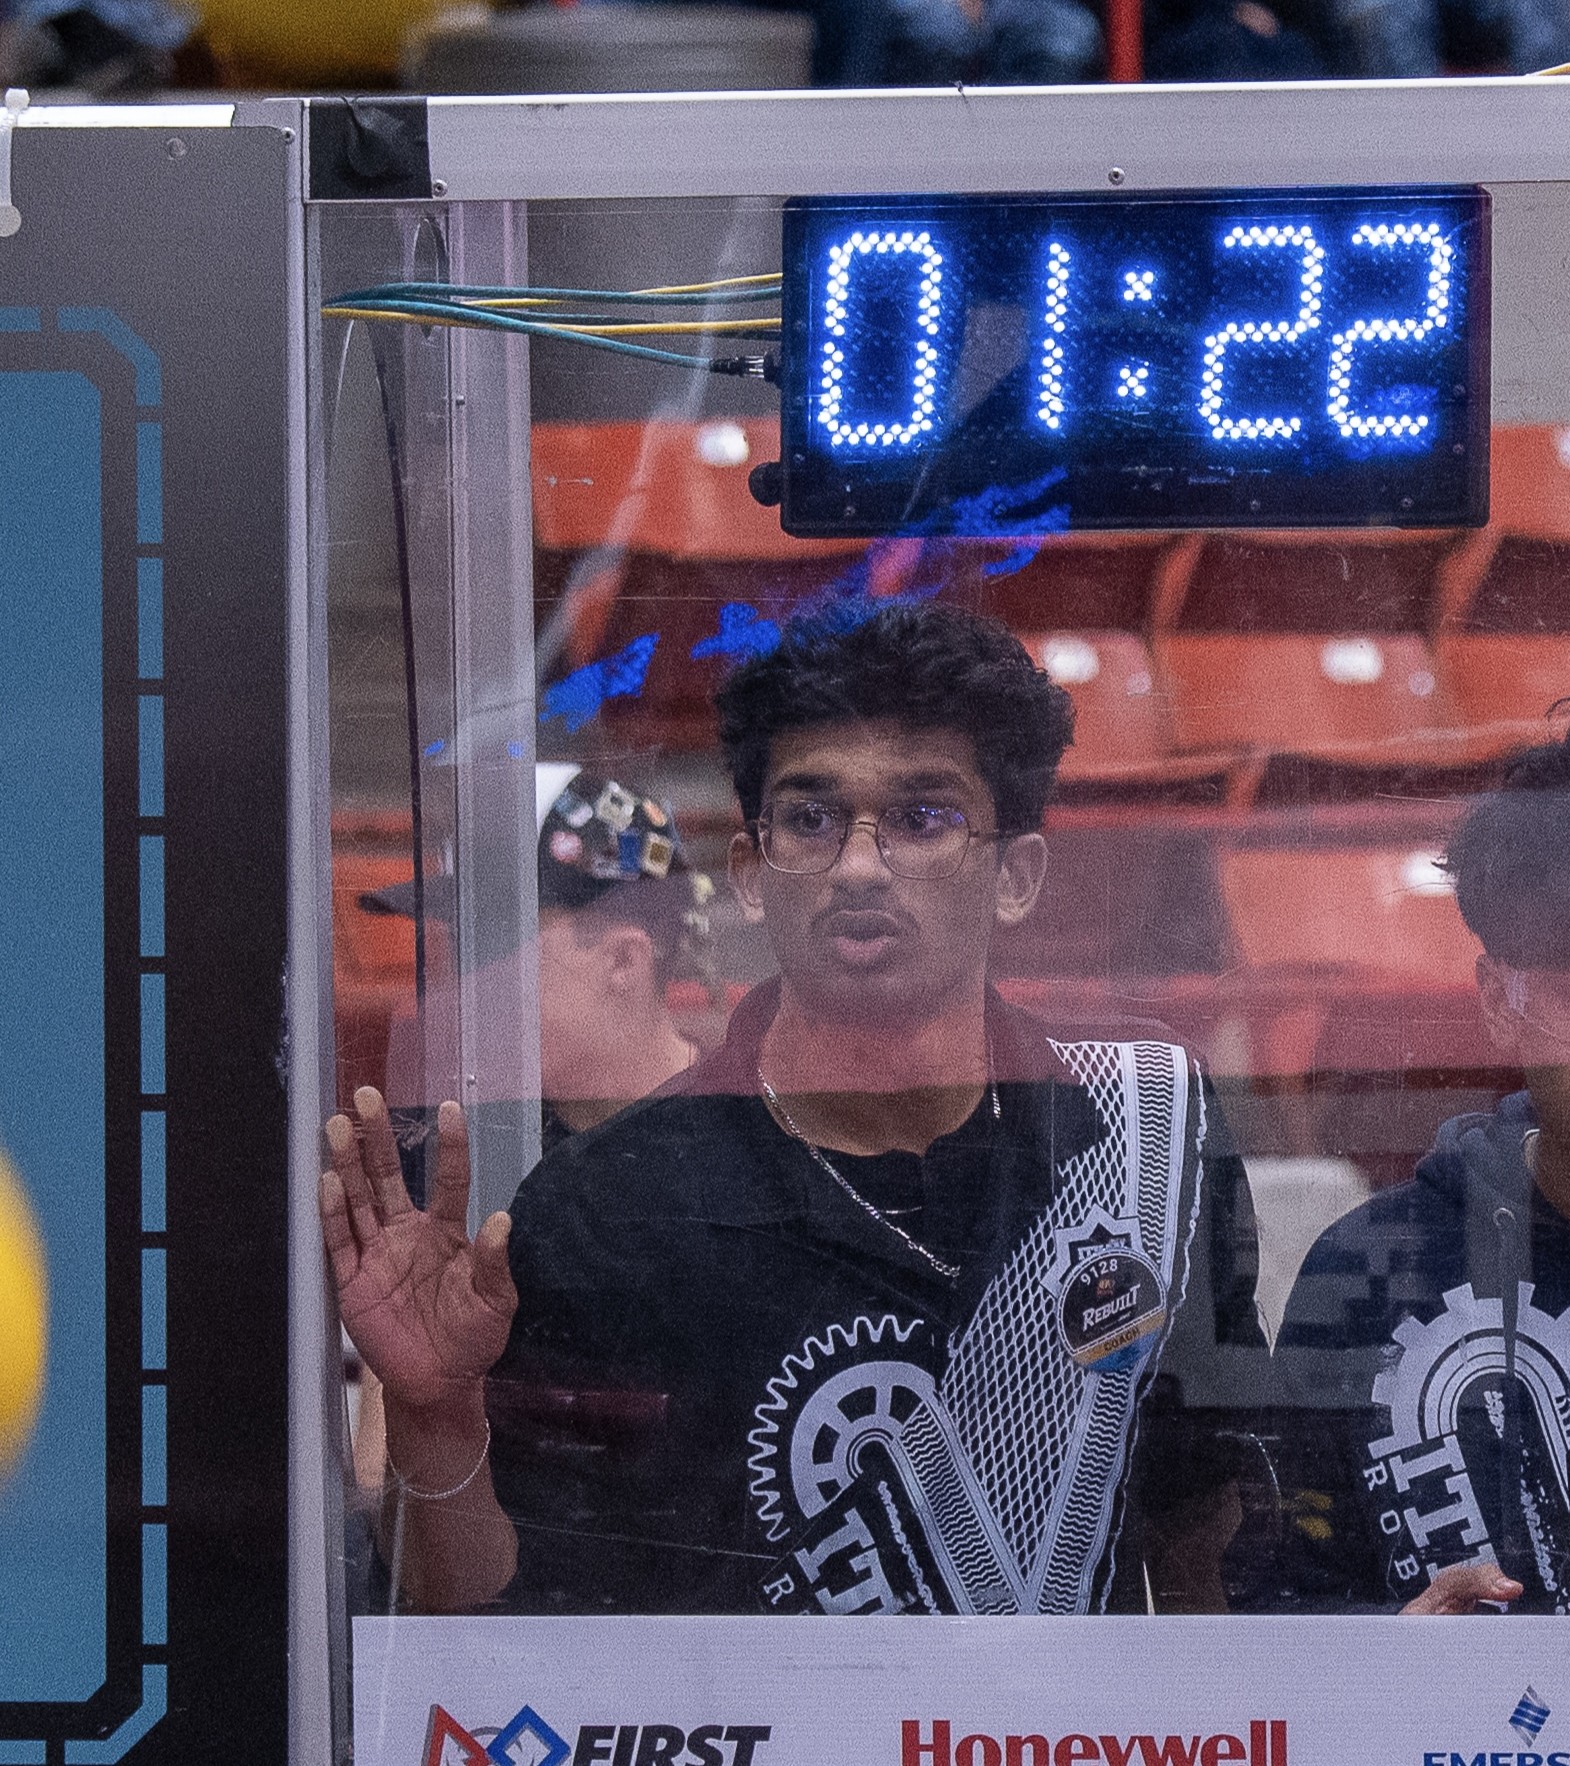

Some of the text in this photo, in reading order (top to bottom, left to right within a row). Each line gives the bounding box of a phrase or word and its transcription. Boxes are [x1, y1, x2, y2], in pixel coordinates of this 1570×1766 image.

[818, 222, 1452, 446] 01:22
[1080, 1258, 1118, 1286] 9128
[1104, 1326, 1140, 1351] COACH
[572, 1725, 772, 1766] FIRST
[901, 1720, 1288, 1766] Honeywell
